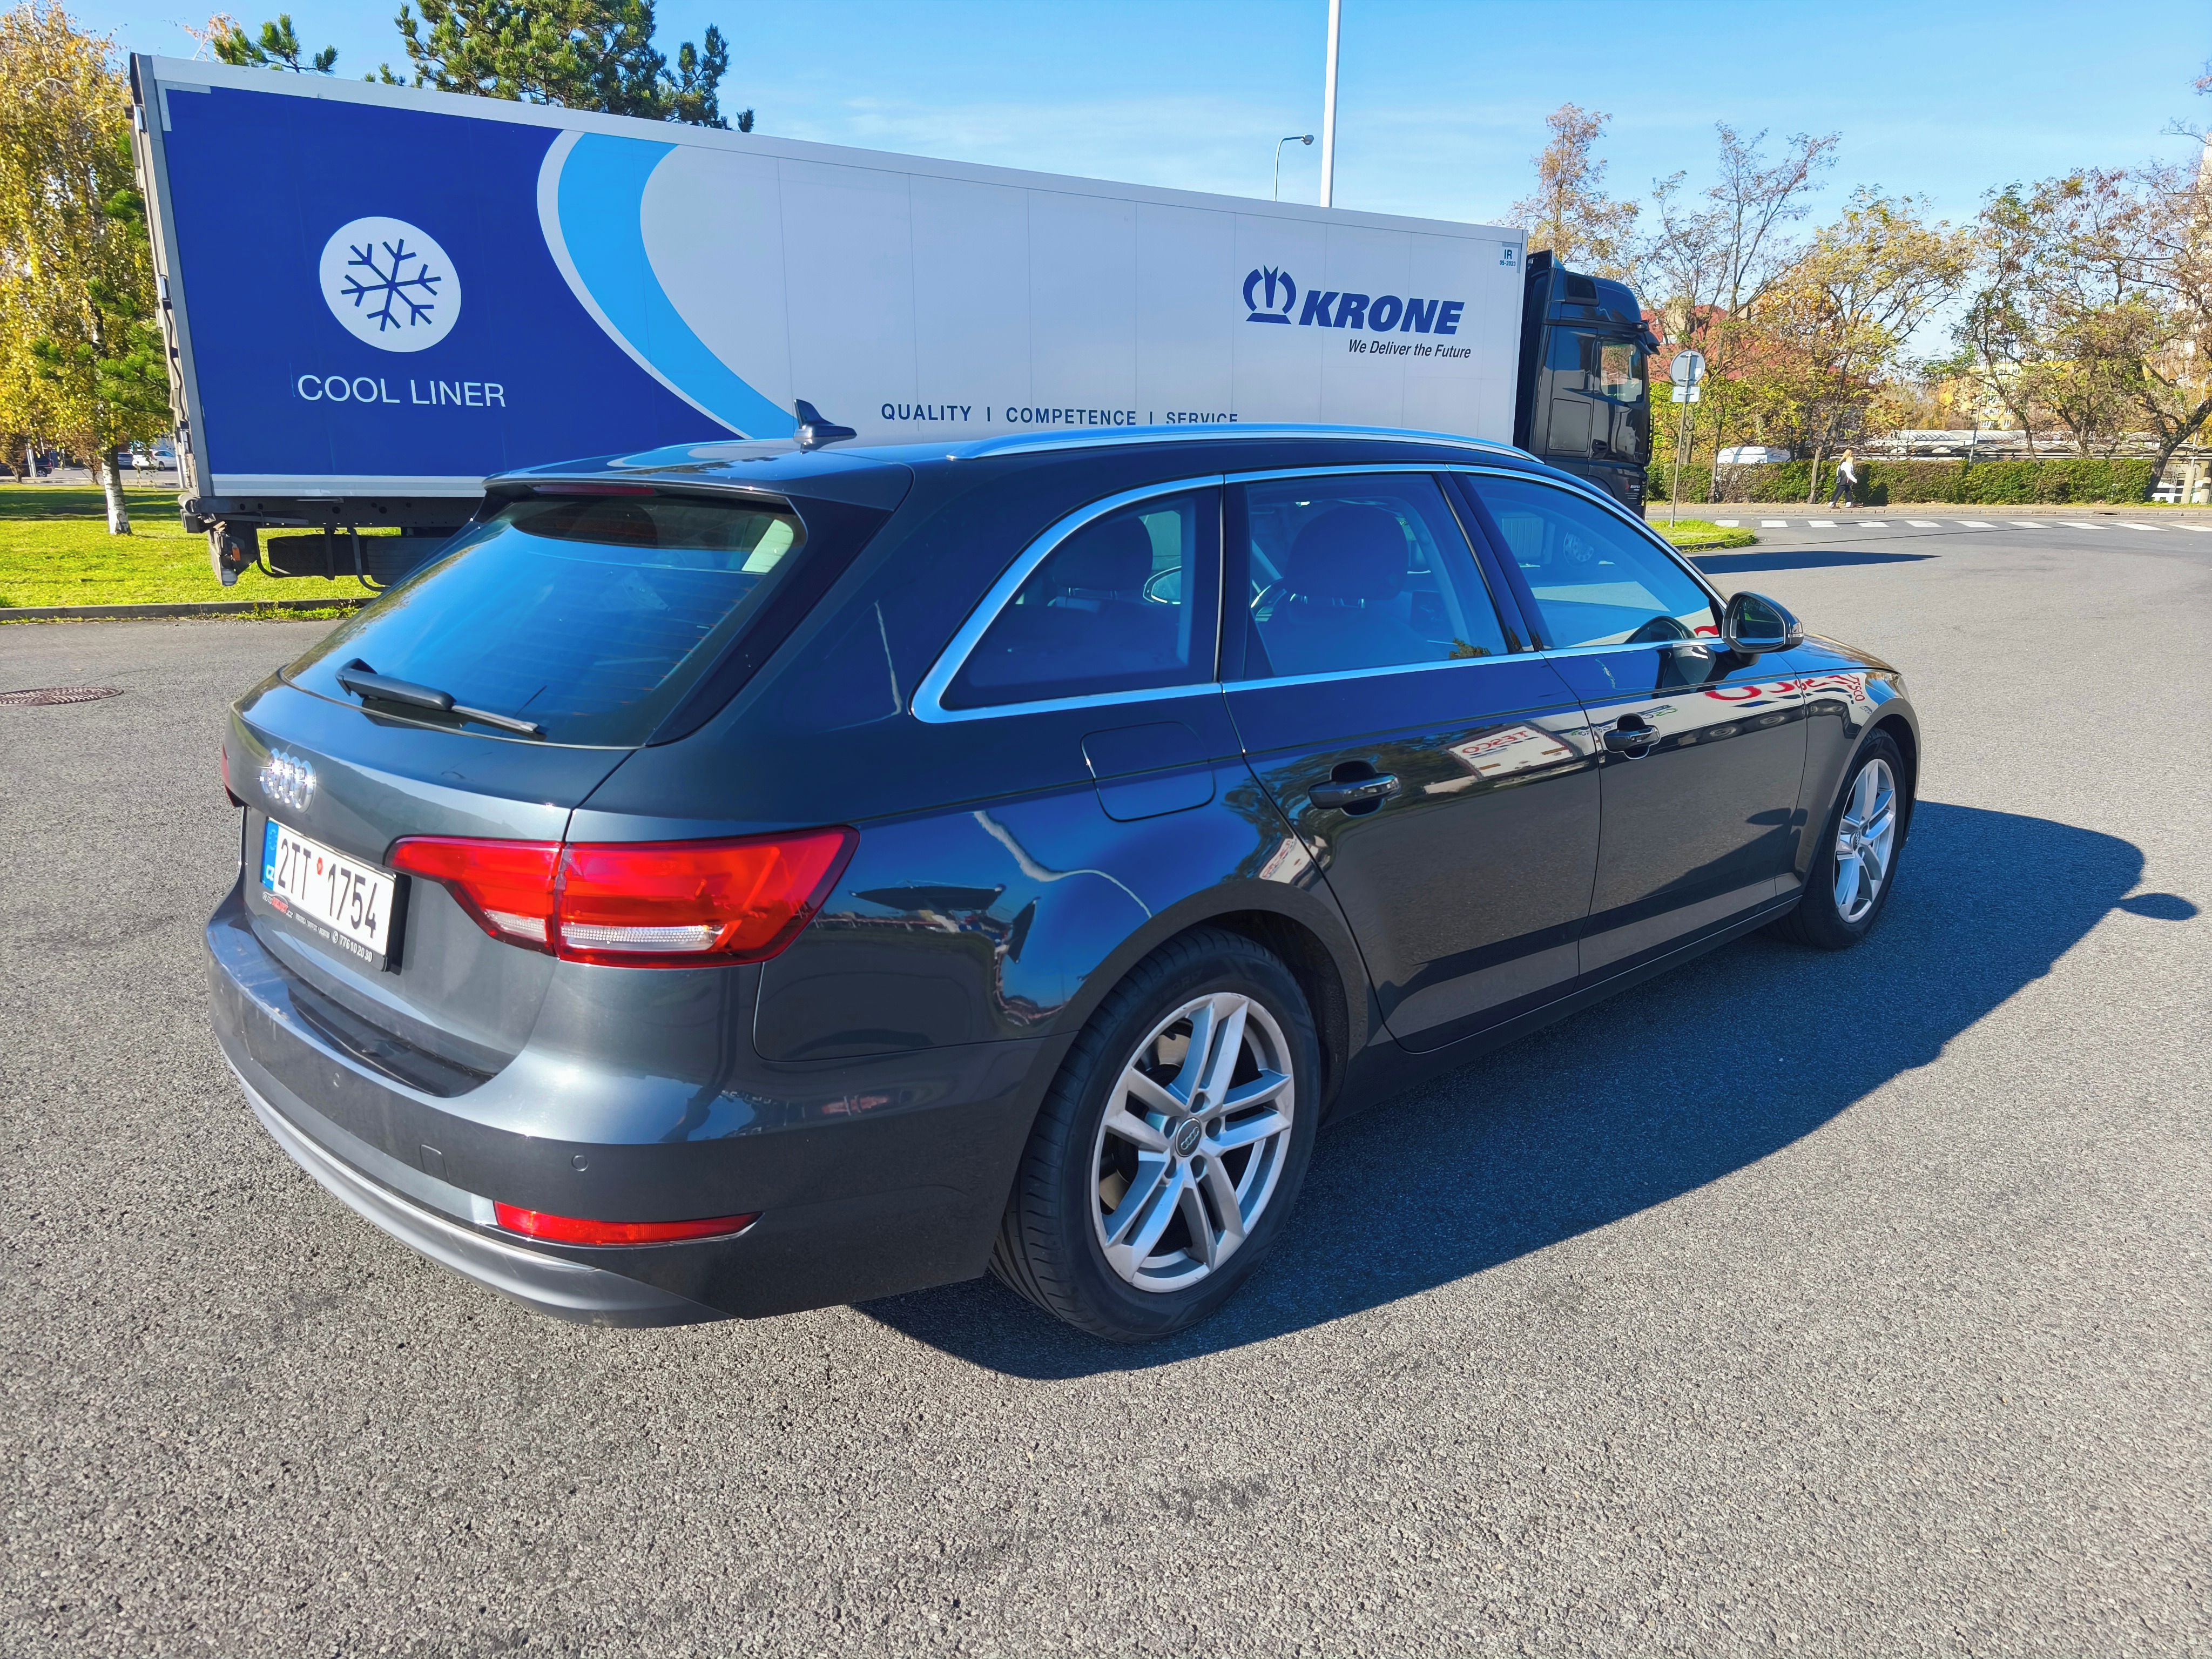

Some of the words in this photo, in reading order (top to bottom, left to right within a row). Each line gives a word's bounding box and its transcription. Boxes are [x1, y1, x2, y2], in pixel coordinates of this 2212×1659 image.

[1504, 249, 1512, 259] IR
[1299, 290, 1465, 335] KRONE
[1349, 339, 1366, 353] We
[1370, 340, 1412, 355] Deliver
[1414, 343, 1432, 356] the
[1434, 345, 1471, 358] Future
[298, 374, 400, 403] COOL
[410, 379, 506, 407] LINER
[881, 403, 972, 421] QUALITY
[1006, 407, 1136, 426] COMPETENCE
[1166, 412, 1238, 424] SERVICE
[278, 838, 311, 900] 2TT
[328, 863, 377, 939] 1754
